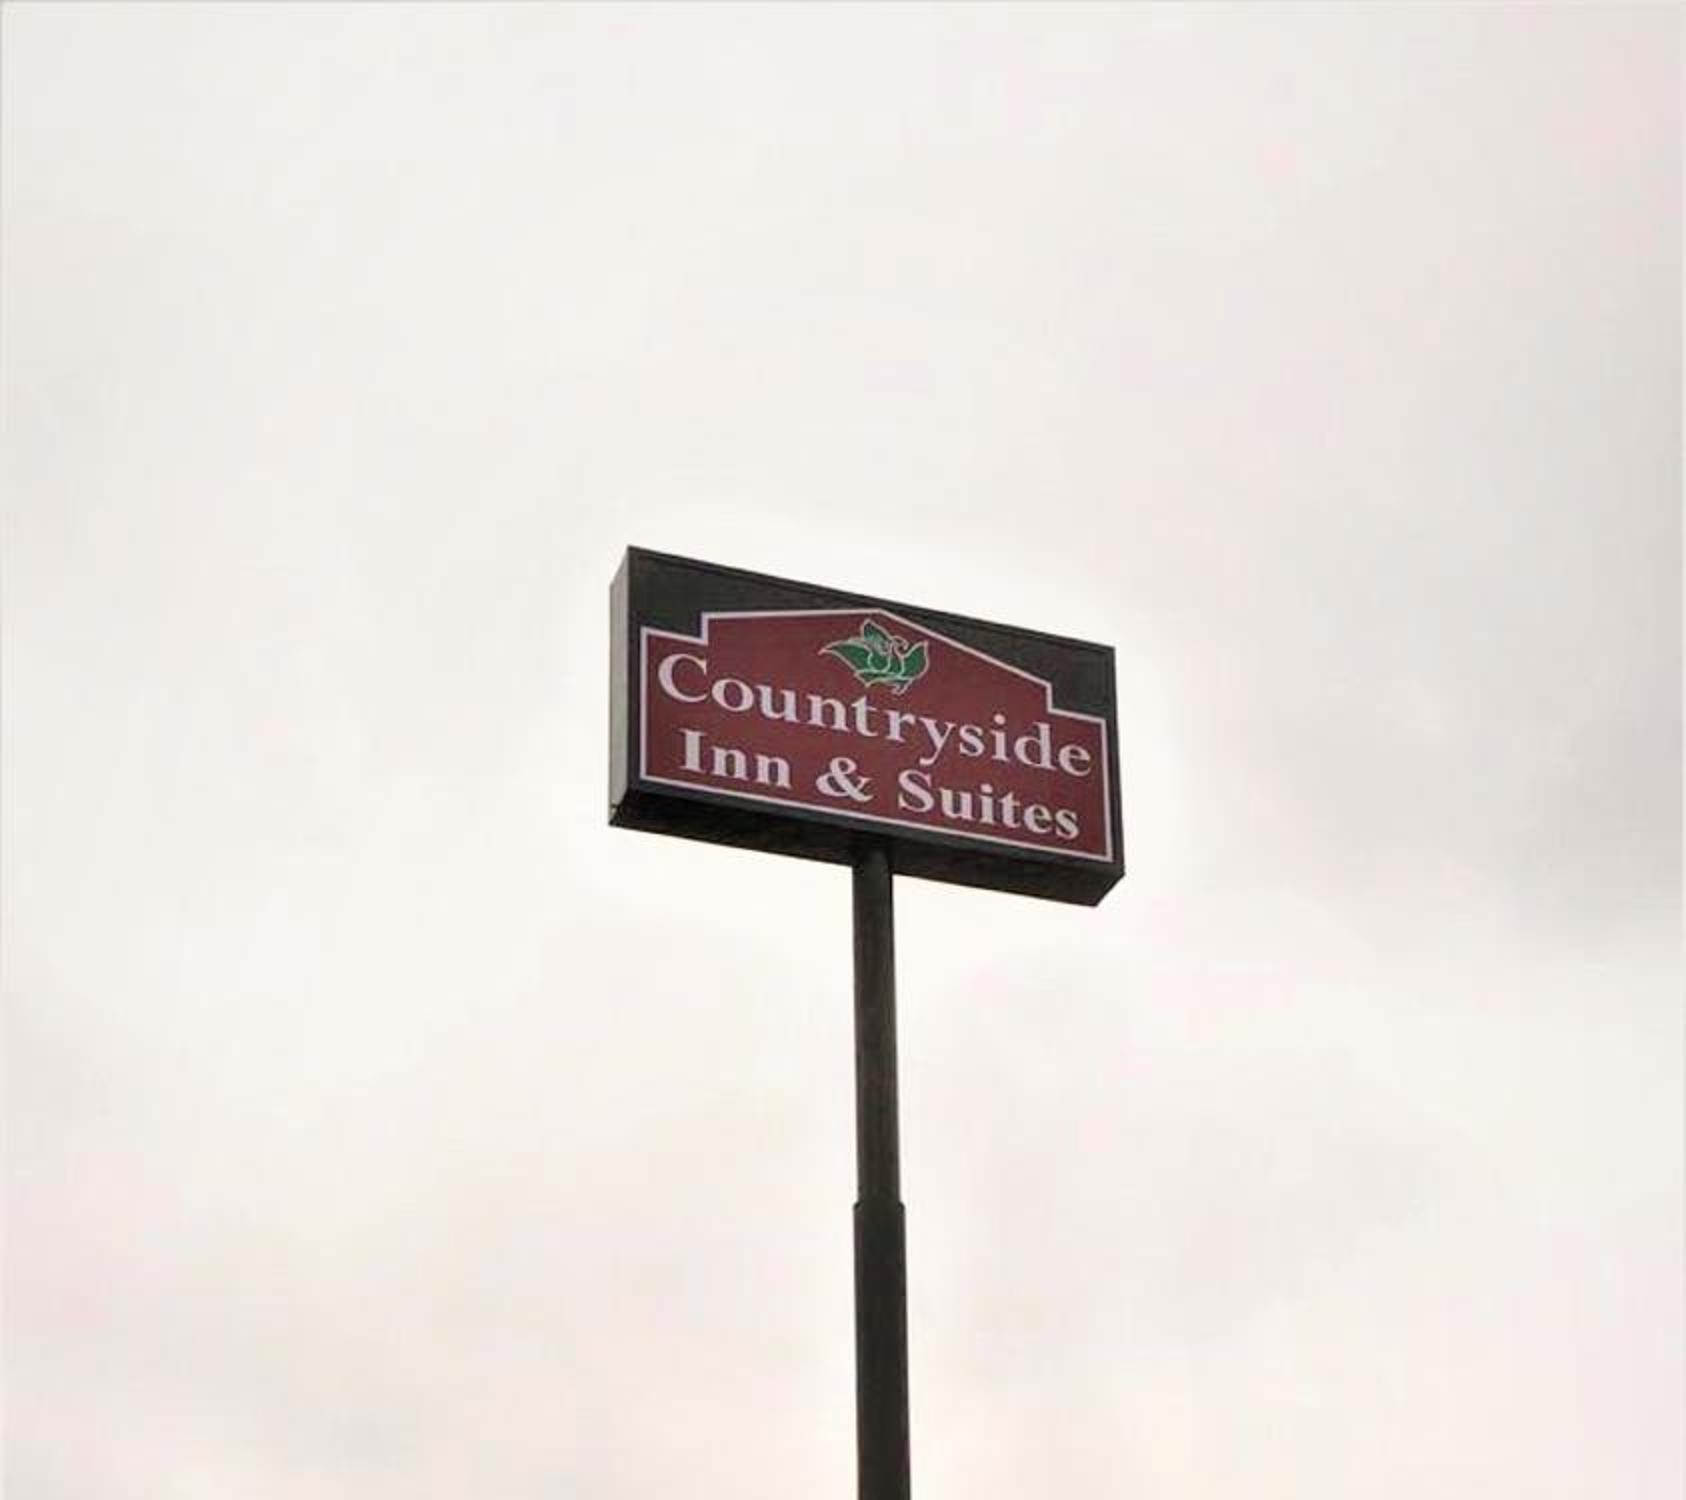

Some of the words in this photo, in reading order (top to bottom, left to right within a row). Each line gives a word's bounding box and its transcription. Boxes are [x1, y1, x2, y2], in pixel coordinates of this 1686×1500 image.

[658, 653, 1092, 777] Countryside
[679, 728, 792, 789] Inn
[816, 756, 874, 803] &
[898, 769, 1080, 840] Suites
